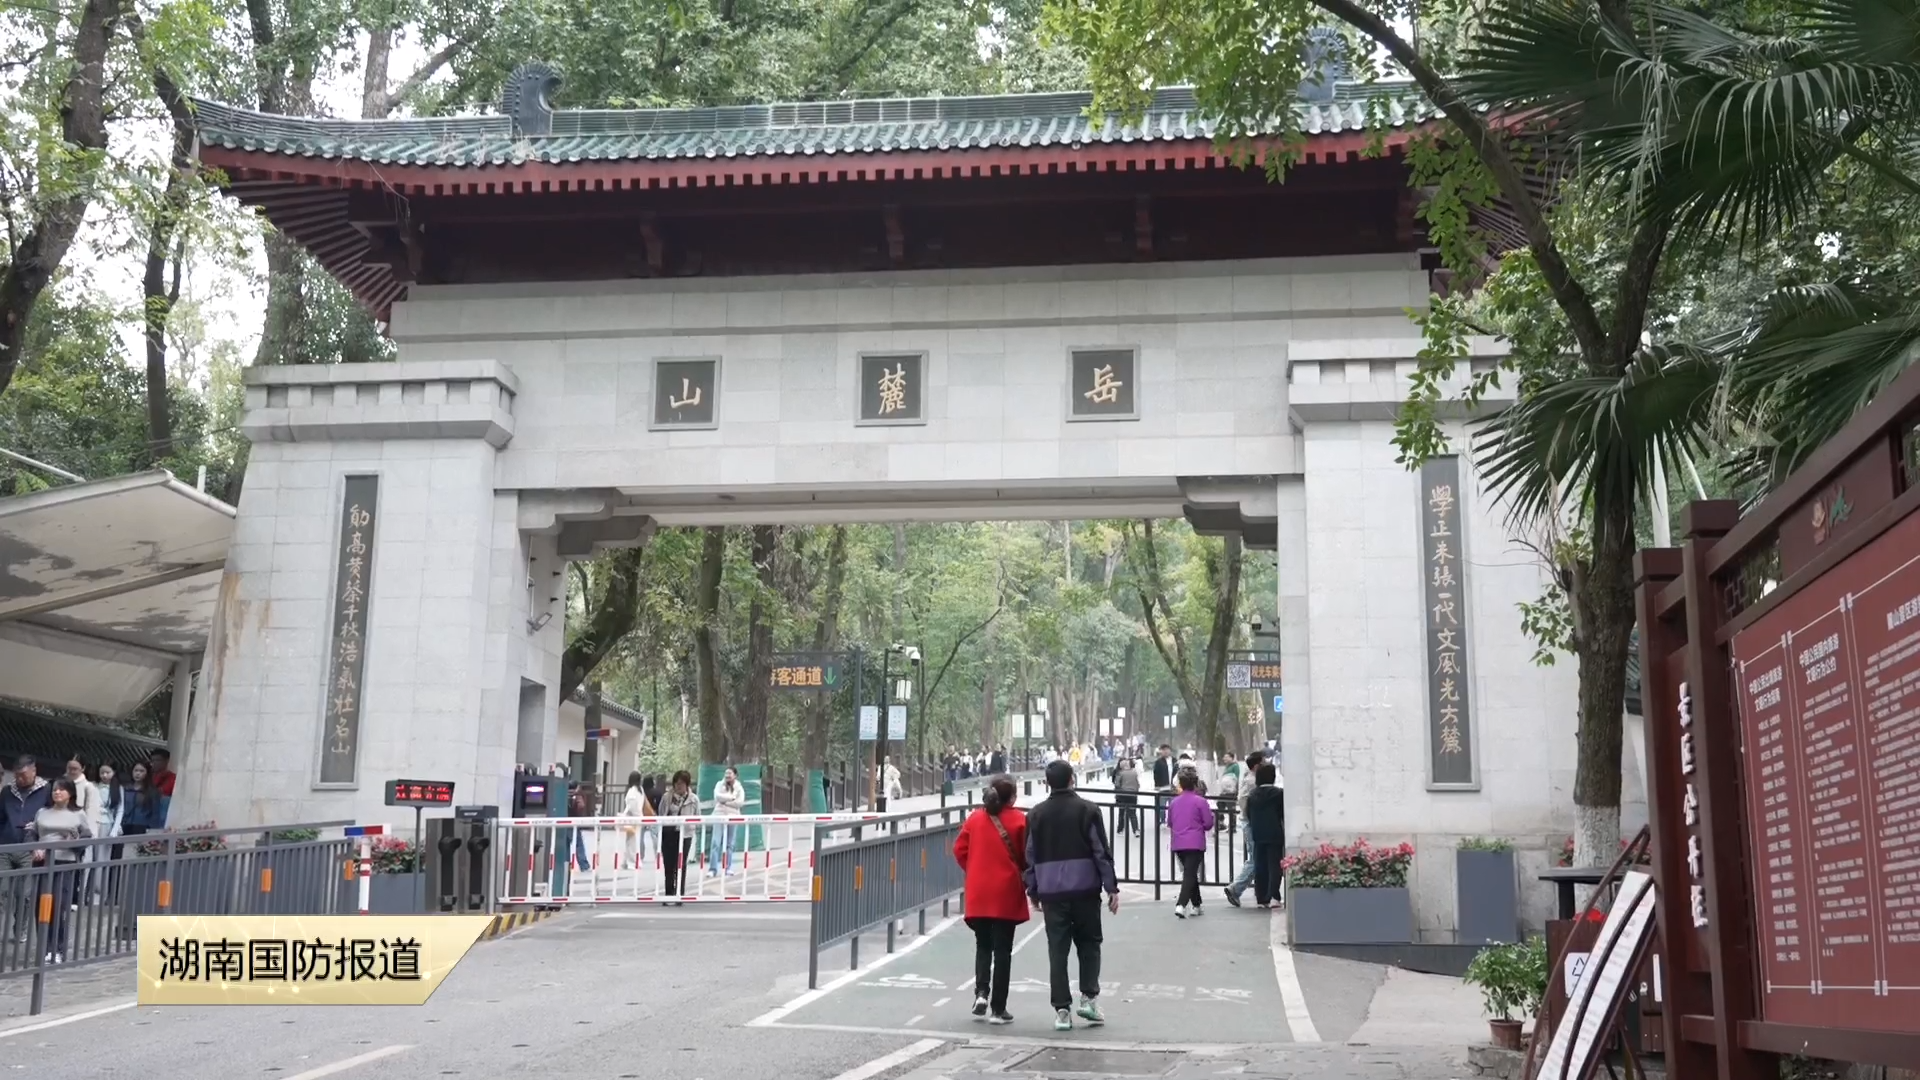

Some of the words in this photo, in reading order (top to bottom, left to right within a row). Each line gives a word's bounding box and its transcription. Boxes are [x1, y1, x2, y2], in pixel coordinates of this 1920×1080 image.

[669, 377, 702, 409] 山
[877, 363, 907, 416] 麓
[1084, 363, 1123, 404] 岳
